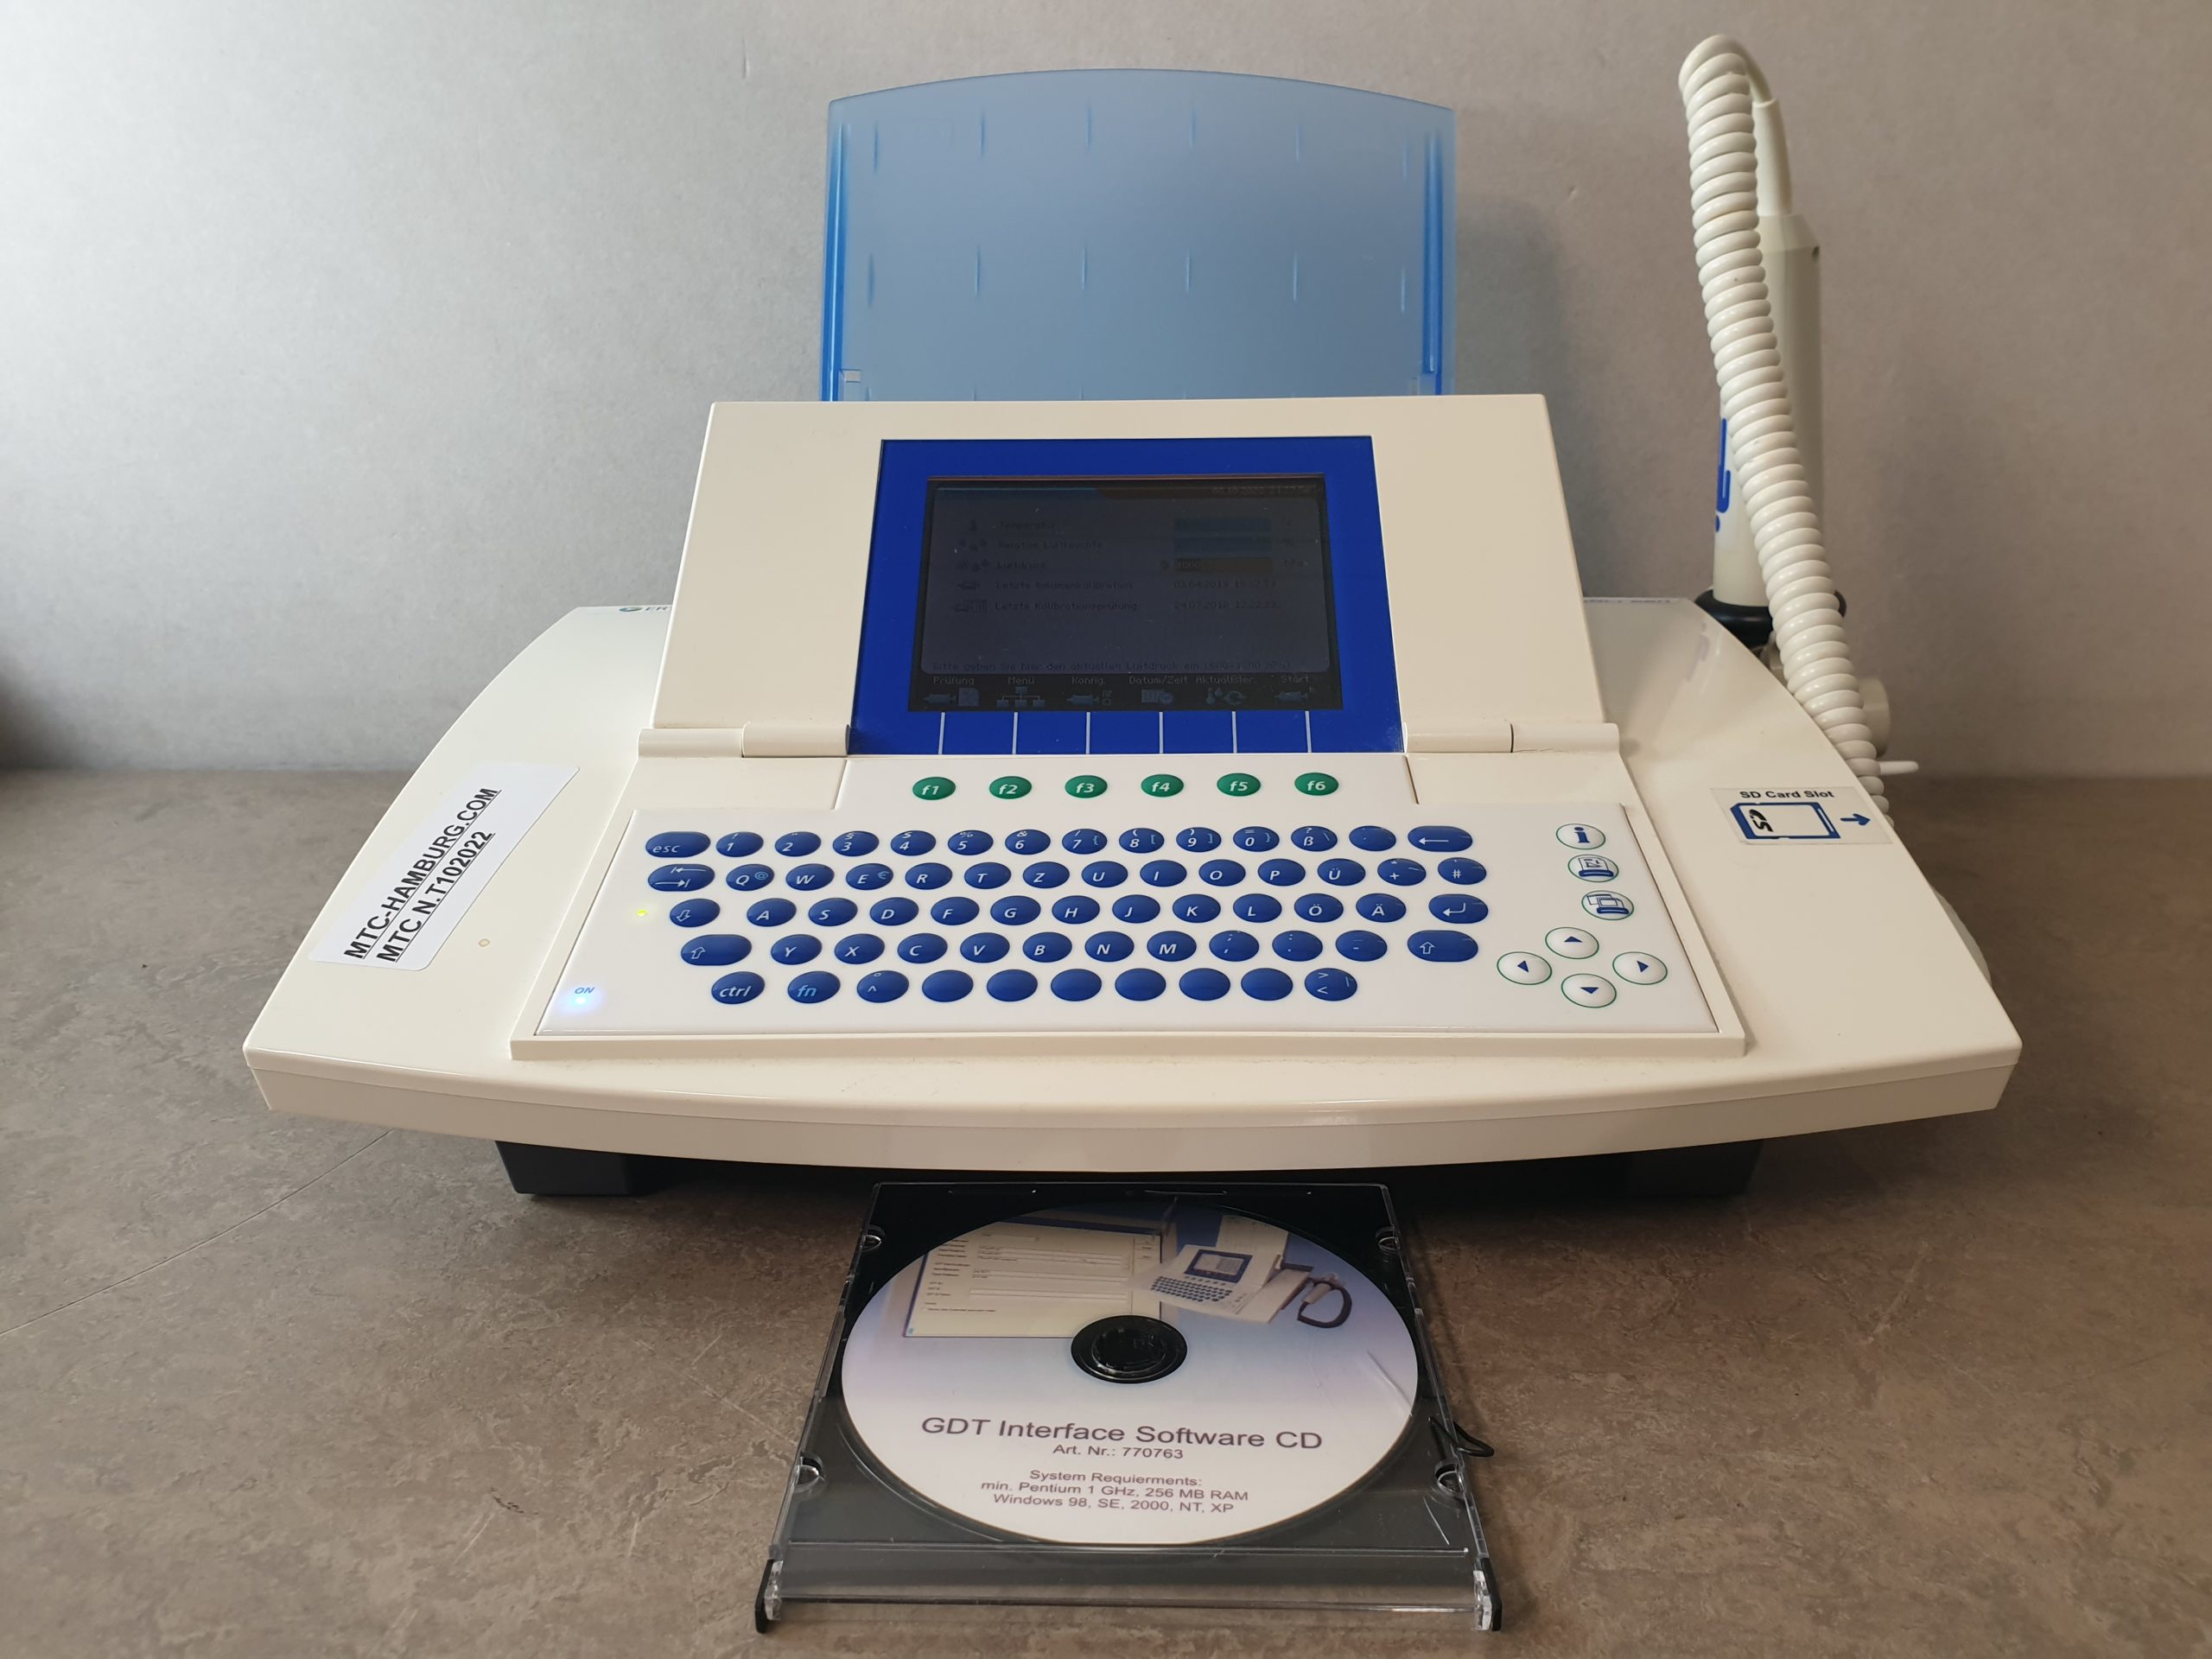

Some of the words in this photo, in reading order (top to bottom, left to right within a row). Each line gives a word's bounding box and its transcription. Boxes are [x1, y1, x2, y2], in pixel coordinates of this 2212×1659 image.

[933, 676, 975, 687] Prüfung
[1007, 676, 1035, 685] Menü
[1128, 675, 1188, 684] Datum/Zeit
[1280, 674, 1310, 684] Start
[921, 783, 940, 796] f1
[998, 783, 1018, 796] f2
[1074, 782, 1095, 795] f3
[1150, 781, 1171, 794] f4
[1229, 780, 1249, 793] f5
[1306, 779, 1327, 792] f6
[1739, 791, 1762, 799] SD
[1765, 791, 1802, 799] Card
[1804, 790, 1835, 798] Slot
[727, 842, 734, 852] 1
[783, 842, 793, 852] 2
[842, 842, 852, 851] 3
[899, 842, 909, 850] 4
[957, 841, 968, 850] 5
[1014, 840, 1025, 849] 6
[1072, 839, 1082, 849] 7
[1129, 838, 1140, 848] 8
[1187, 837, 1198, 847] 9
[652, 844, 680, 854] esc
[343, 787, 499, 960] MTC-HAMBURG.COM
[857, 874, 869, 884] E
[916, 874, 928, 884] R
[977, 873, 988, 883] T
[1033, 873, 1046, 883] Z
[1092, 872, 1105, 882] U
[1269, 870, 1280, 880] P
[1329, 868, 1340, 880] Ü
[735, 874, 750, 886] Q
[796, 874, 815, 885] W
[376, 918, 422, 963] MTC
[412, 830, 494, 915] N.T102022
[819, 910, 831, 920] S
[880, 910, 895, 919] D
[942, 909, 953, 919] F
[1003, 908, 1018, 918] G
[1065, 907, 1078, 918] H
[1124, 906, 1134, 918] J
[1186, 906, 1198, 917] K
[1247, 906, 1256, 917] L
[1308, 903, 1323, 917] Ö
[1371, 903, 1386, 916] Ä
[756, 911, 770, 920] A
[785, 947, 798, 957] Y
[845, 946, 860, 957] X
[909, 945, 922, 957] C
[973, 945, 987, 956] V
[1034, 945, 1046, 956] B
[1096, 944, 1111, 955] N
[1159, 944, 1177, 955] M
[719, 985, 752, 997] ctrl
[797, 985, 817, 997] fn
[921, 1417, 991, 1435] GDT
[999, 1420, 1126, 1441] Interface
[1135, 1426, 1265, 1447] Software
[1275, 1431, 1323, 1449] CD
[1052, 1444, 1082, 1455] Art.
[1087, 1445, 1116, 1457] Nr.:
[1122, 1446, 1184, 1459] 770763
[1029, 1469, 1086, 1483] System
[1091, 1471, 1202, 1486] Requierments:
[981, 1480, 1013, 1491] min.
[1019, 1481, 1081, 1494] Pentium
[1087, 1484, 1095, 1494] 1
[1101, 1485, 1140, 1497] GHz,
[1145, 1487, 1173, 1498] 256
[1179, 1488, 1205, 1499] MB
[1210, 1490, 1249, 1501] RAM
[994, 1493, 1063, 1506] Windows
[1211, 1503, 1235, 1513] XP
